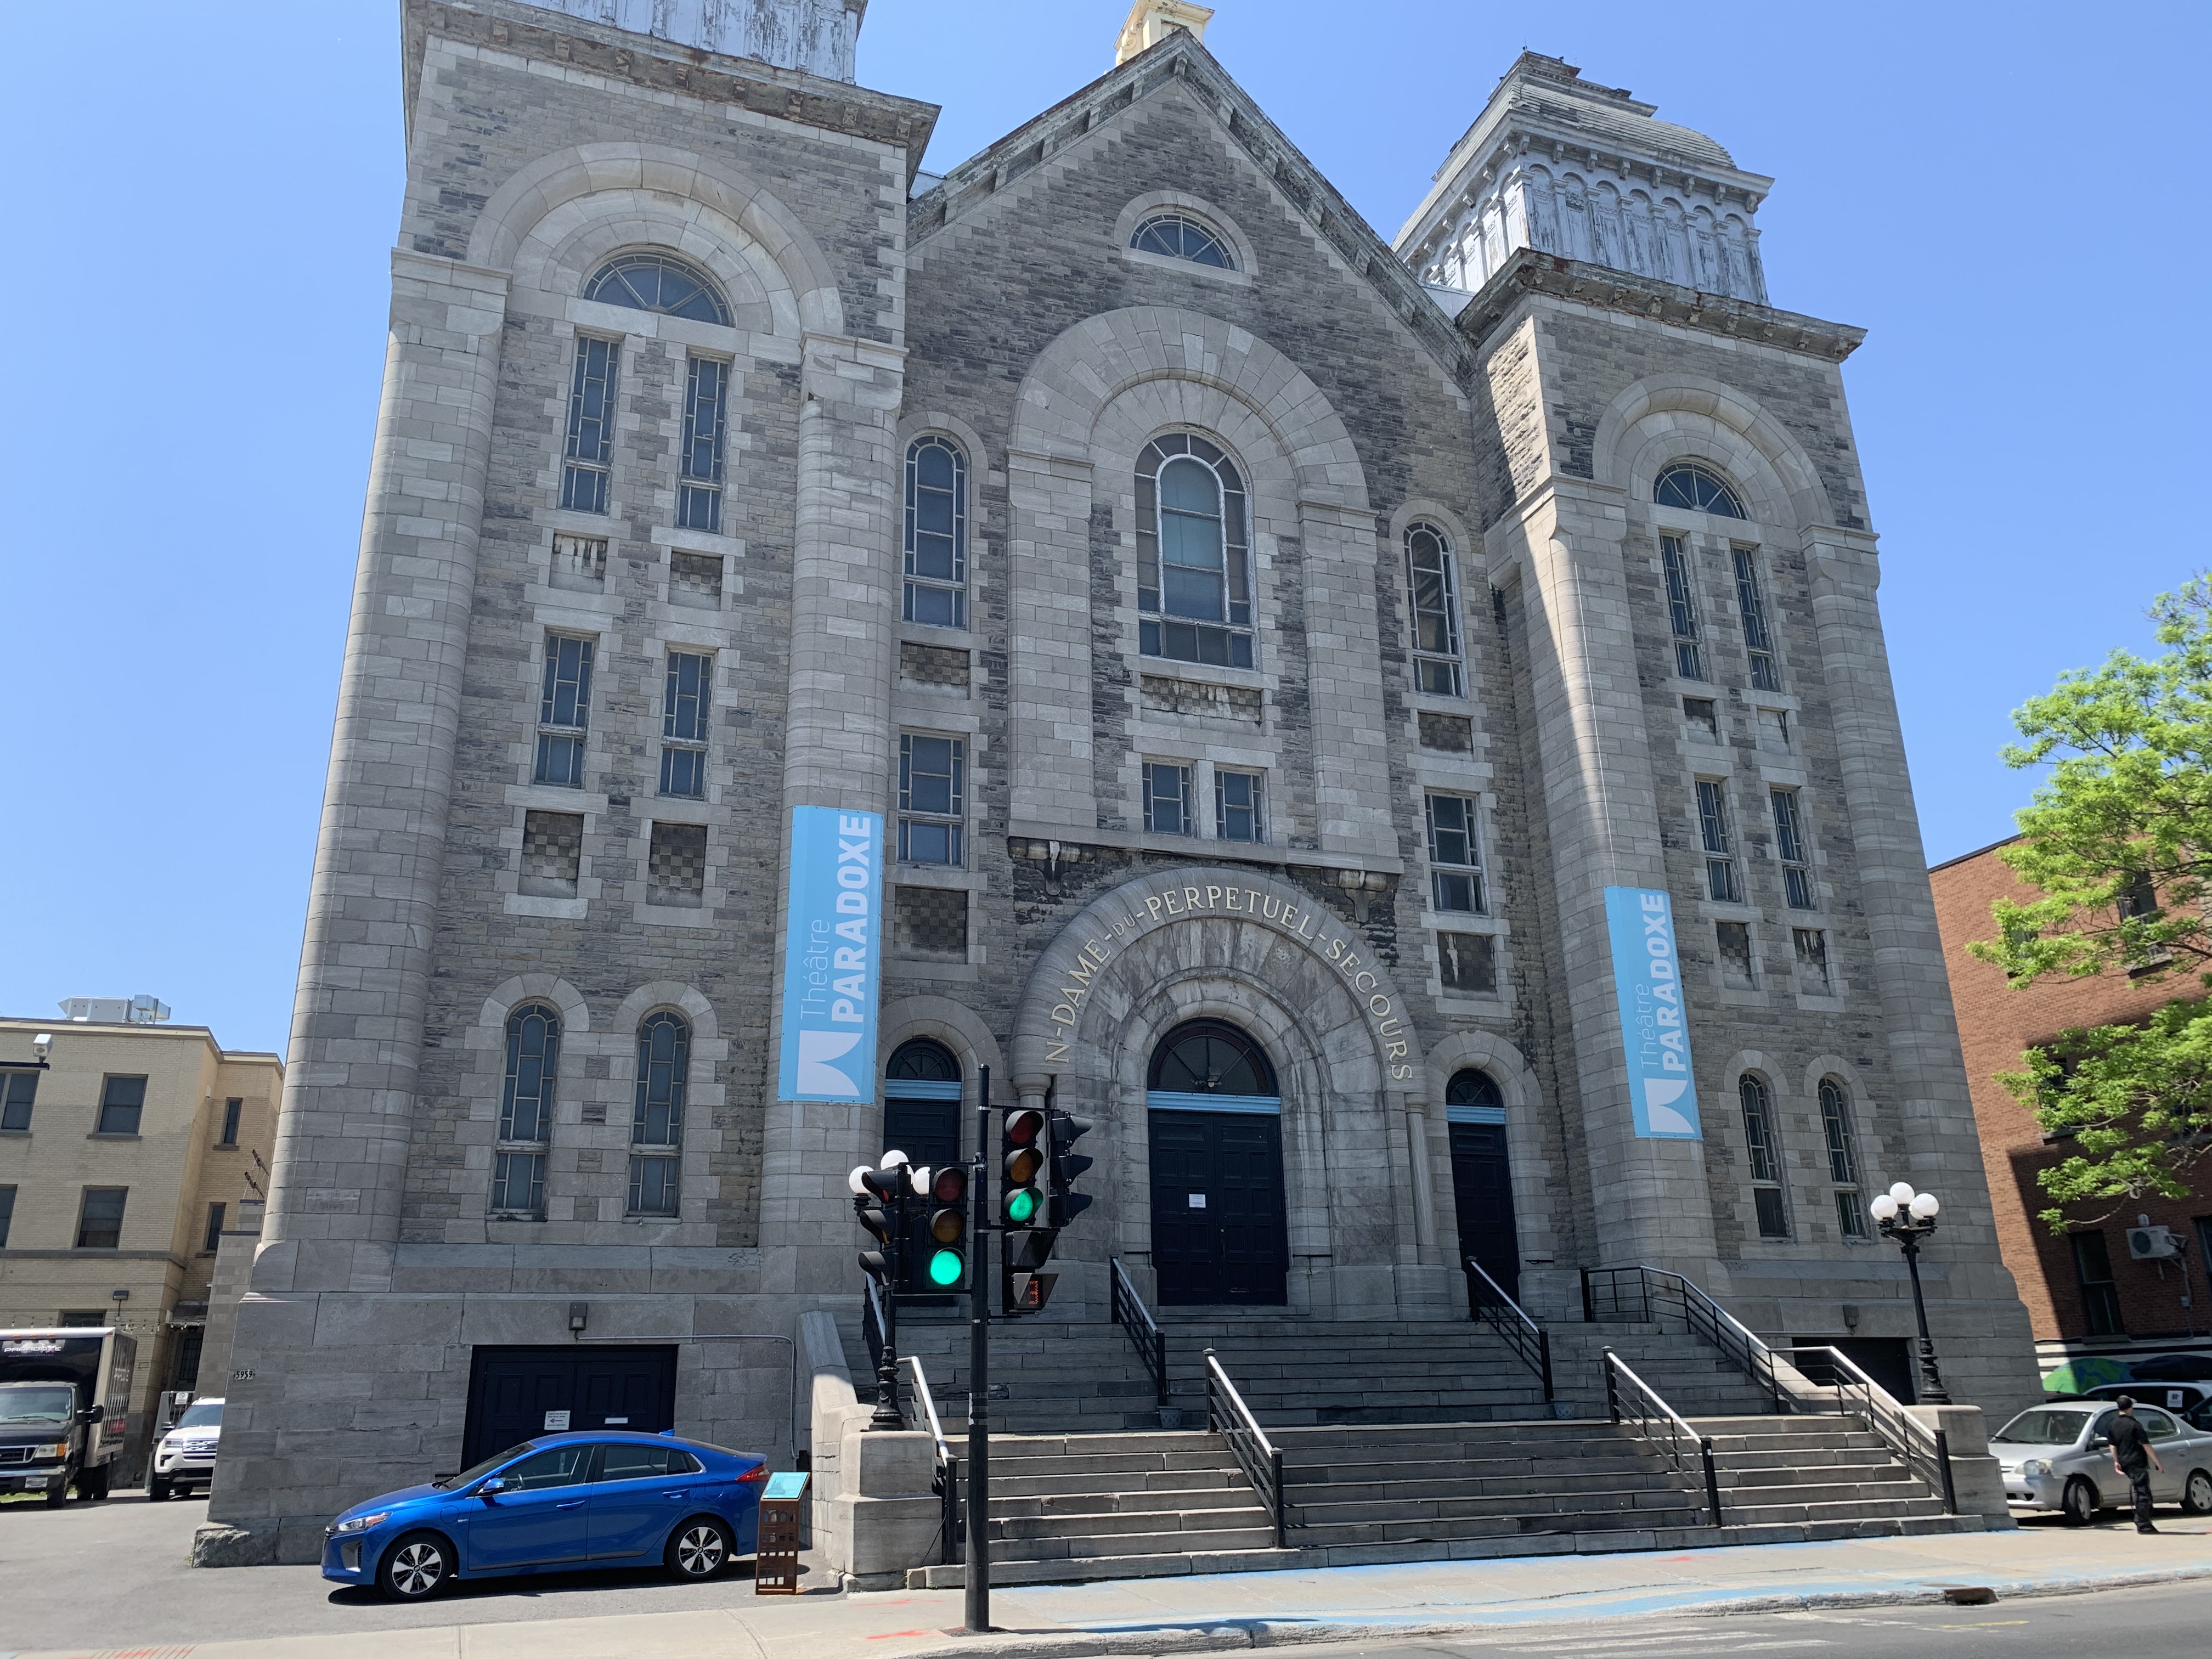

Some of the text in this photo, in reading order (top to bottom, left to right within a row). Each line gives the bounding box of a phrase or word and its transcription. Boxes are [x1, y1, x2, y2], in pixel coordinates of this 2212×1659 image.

[800, 919, 830, 1019] Théâtre
[831, 815, 871, 1023] PARADOXE
[1635, 984, 1659, 1069] Théâtre
[1640, 893, 1687, 1071] PARADOXE
[236, 1371, 253, 1379] 5959
